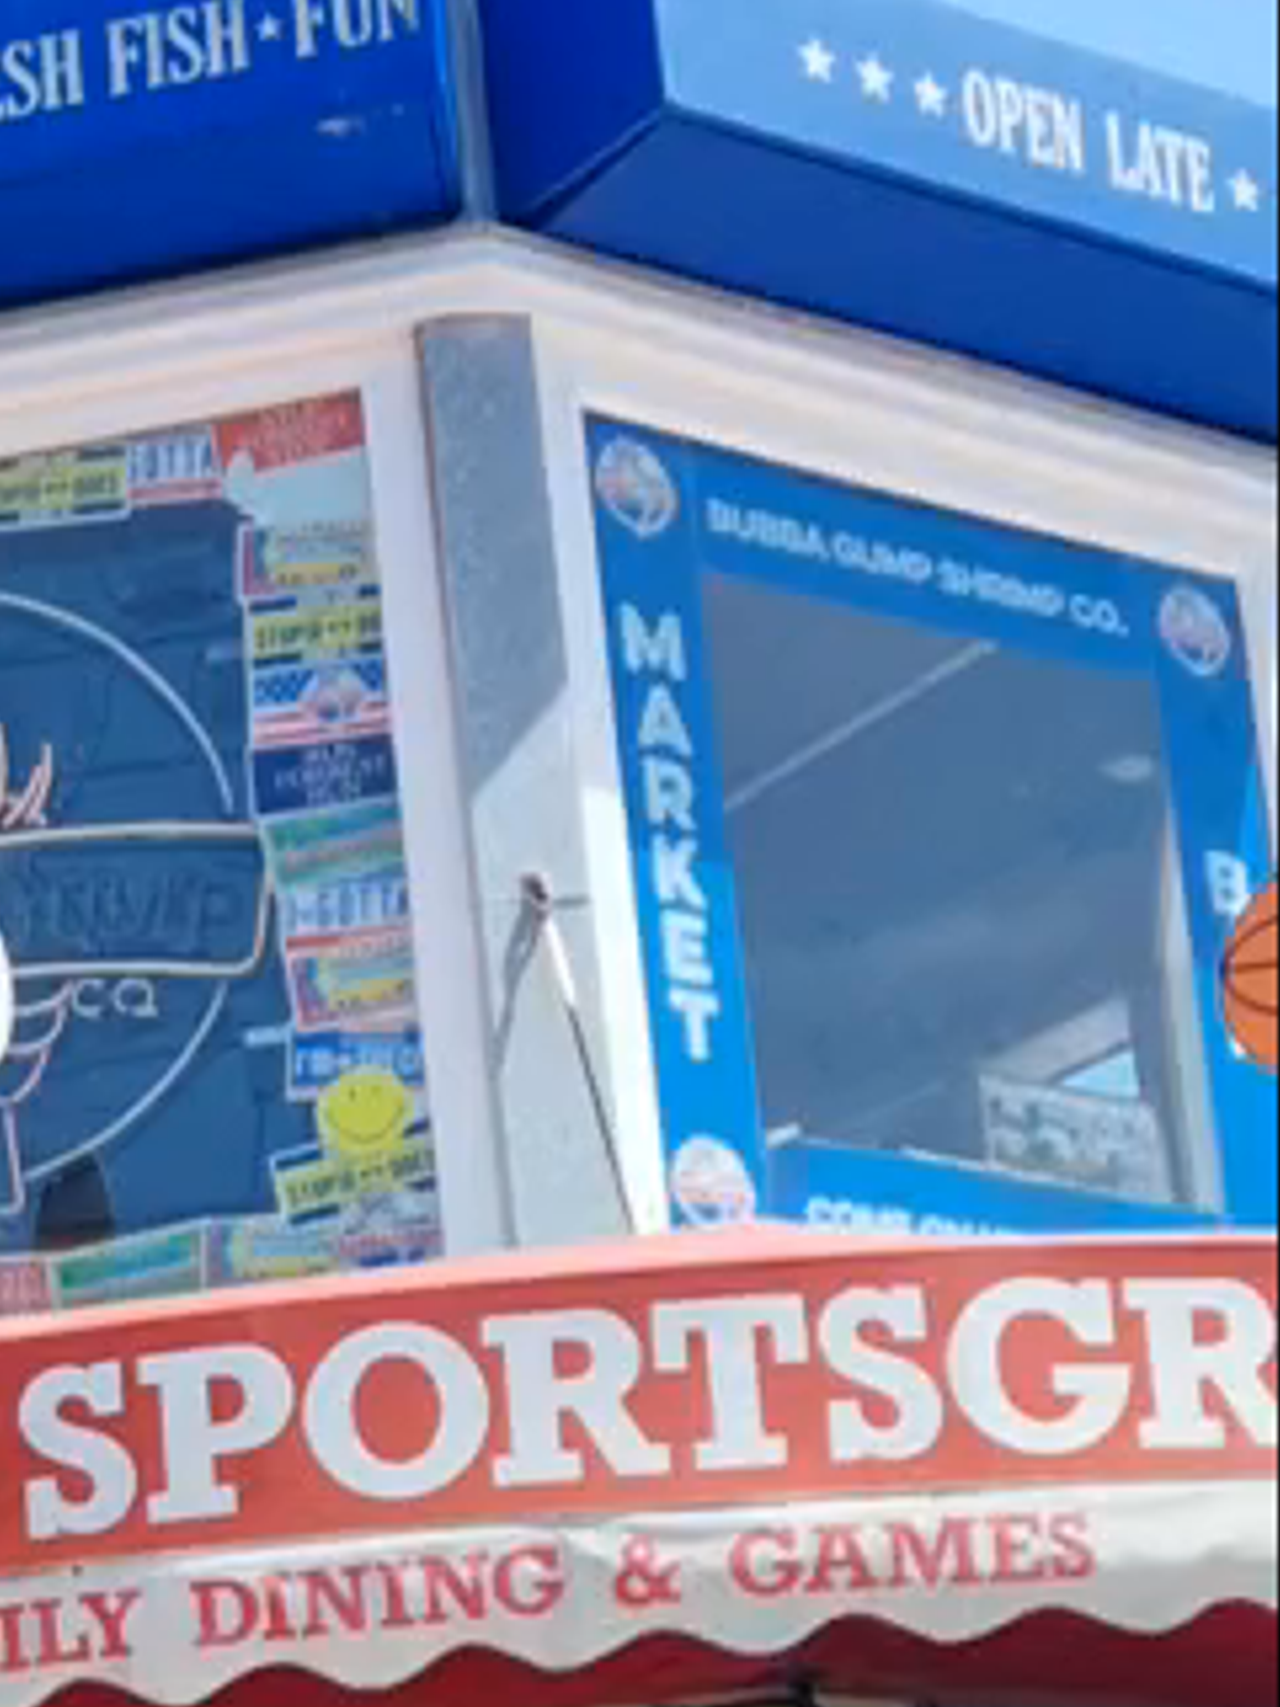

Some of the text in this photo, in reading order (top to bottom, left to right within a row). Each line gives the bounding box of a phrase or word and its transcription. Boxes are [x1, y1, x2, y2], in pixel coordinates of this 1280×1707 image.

[107, 3, 251, 94] FISH
[961, 70, 1214, 213] OPEN LATE
[616, 602, 721, 1063] MARKET
[191, 1544, 566, 1650] DINING
[612, 1533, 682, 1609] &
[726, 1511, 1096, 1600] GAMES
